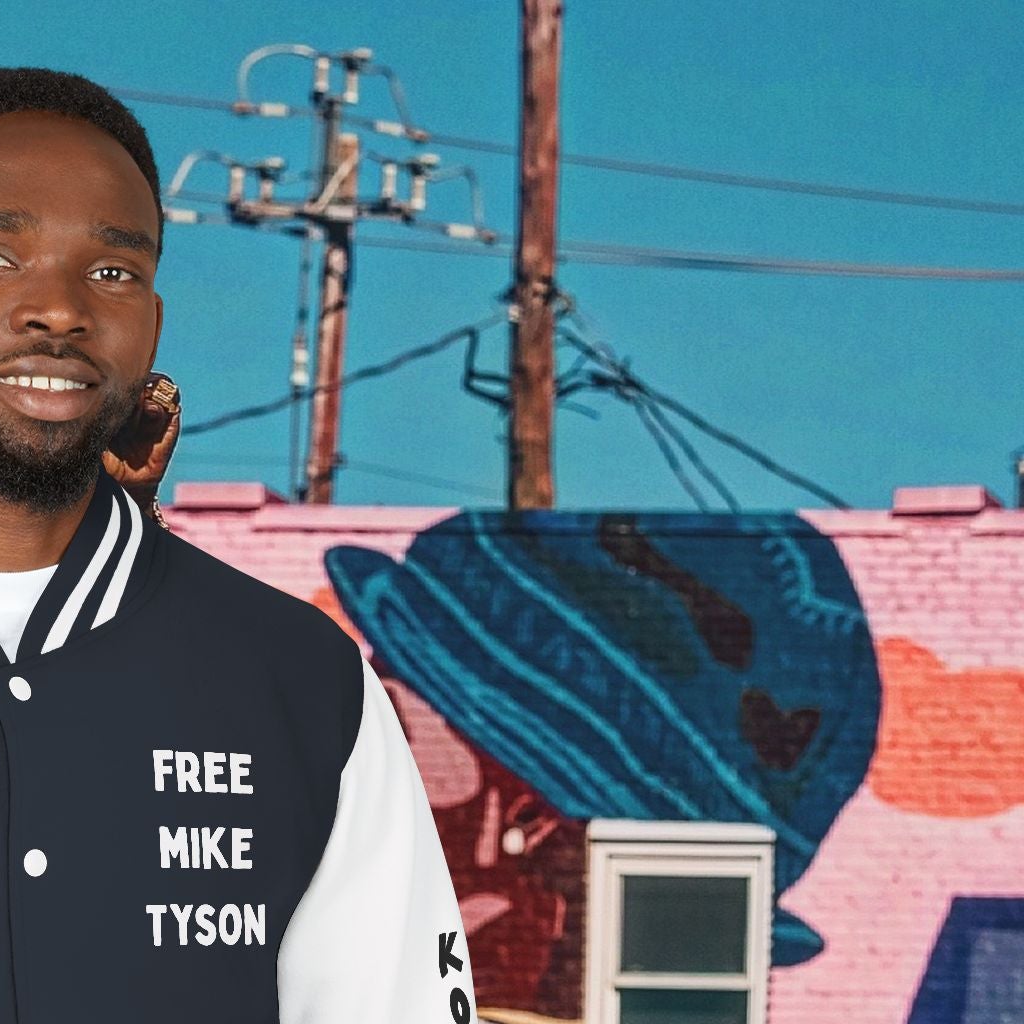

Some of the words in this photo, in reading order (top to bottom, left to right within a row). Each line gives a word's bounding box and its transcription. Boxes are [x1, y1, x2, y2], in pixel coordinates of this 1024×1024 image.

[152, 749, 254, 795] FREE
[158, 825, 254, 870] MIKE
[145, 903, 266, 947] TYSON
